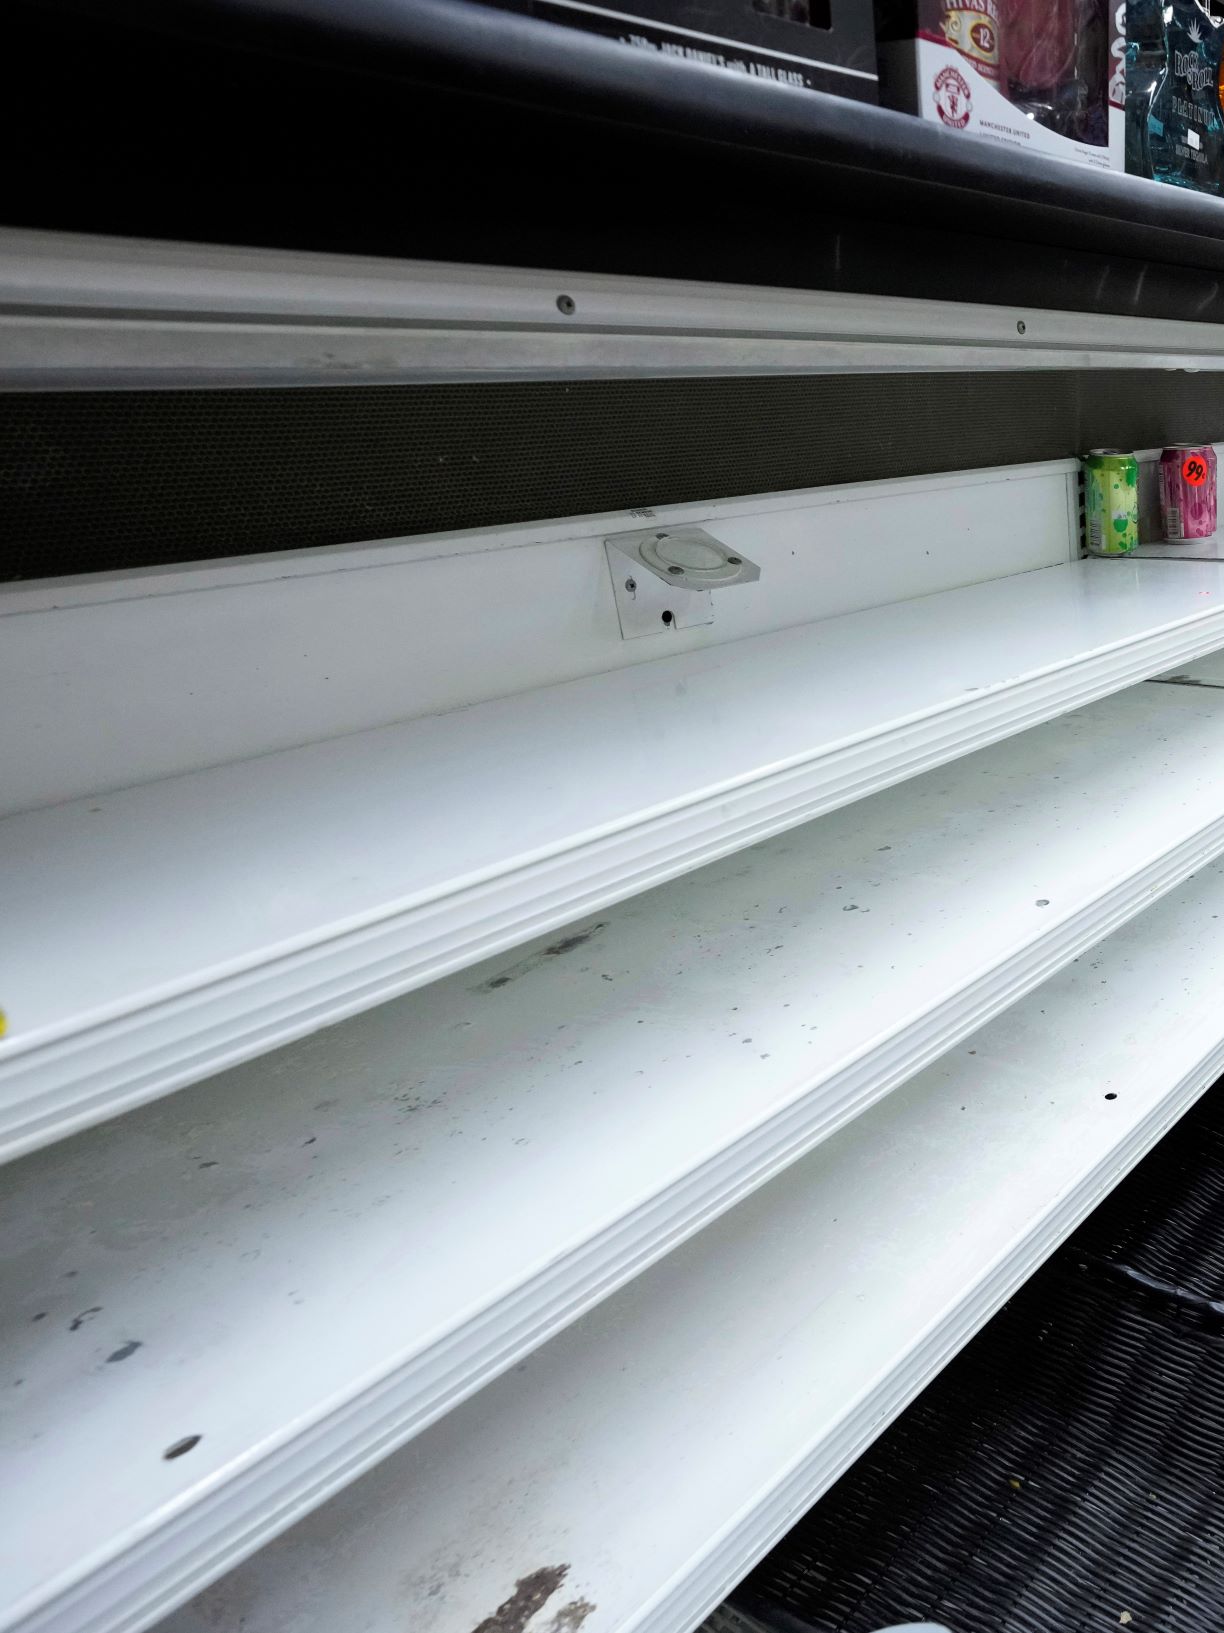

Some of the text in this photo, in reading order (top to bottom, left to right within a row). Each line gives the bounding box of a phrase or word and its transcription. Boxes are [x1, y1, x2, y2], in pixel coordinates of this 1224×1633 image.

[980, 28, 991, 48] 12
[777, 68, 804, 86] GLASS
[1192, 67, 1214, 91] ROLL
[979, 119, 1031, 140] MANCHESTER UNITED
